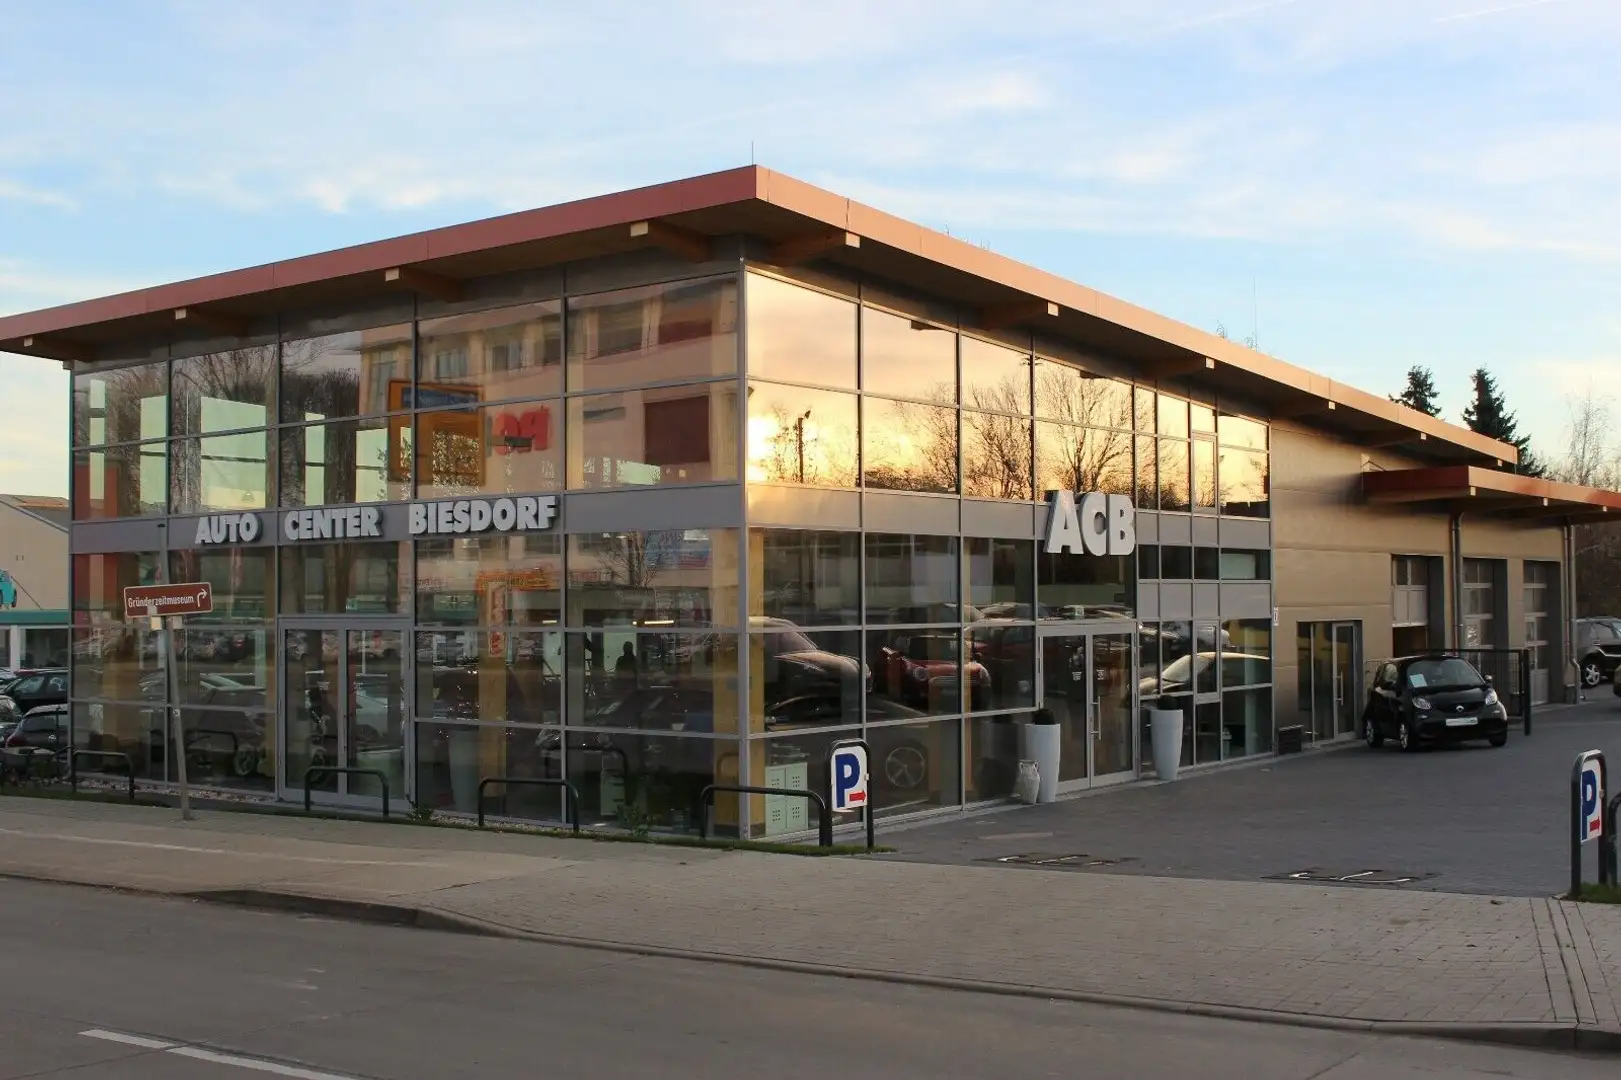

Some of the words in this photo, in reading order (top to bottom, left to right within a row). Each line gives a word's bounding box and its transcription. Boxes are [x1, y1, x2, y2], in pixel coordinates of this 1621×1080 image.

[195, 513, 260, 545] AUTO
[284, 506, 381, 541] CENTER
[409, 496, 556, 534] BIESDORF
[1044, 489, 1136, 556] ACB
[127, 595, 194, 608] Gründerzeitmuseum
[835, 753, 860, 808] P
[1581, 769, 1597, 841] P
